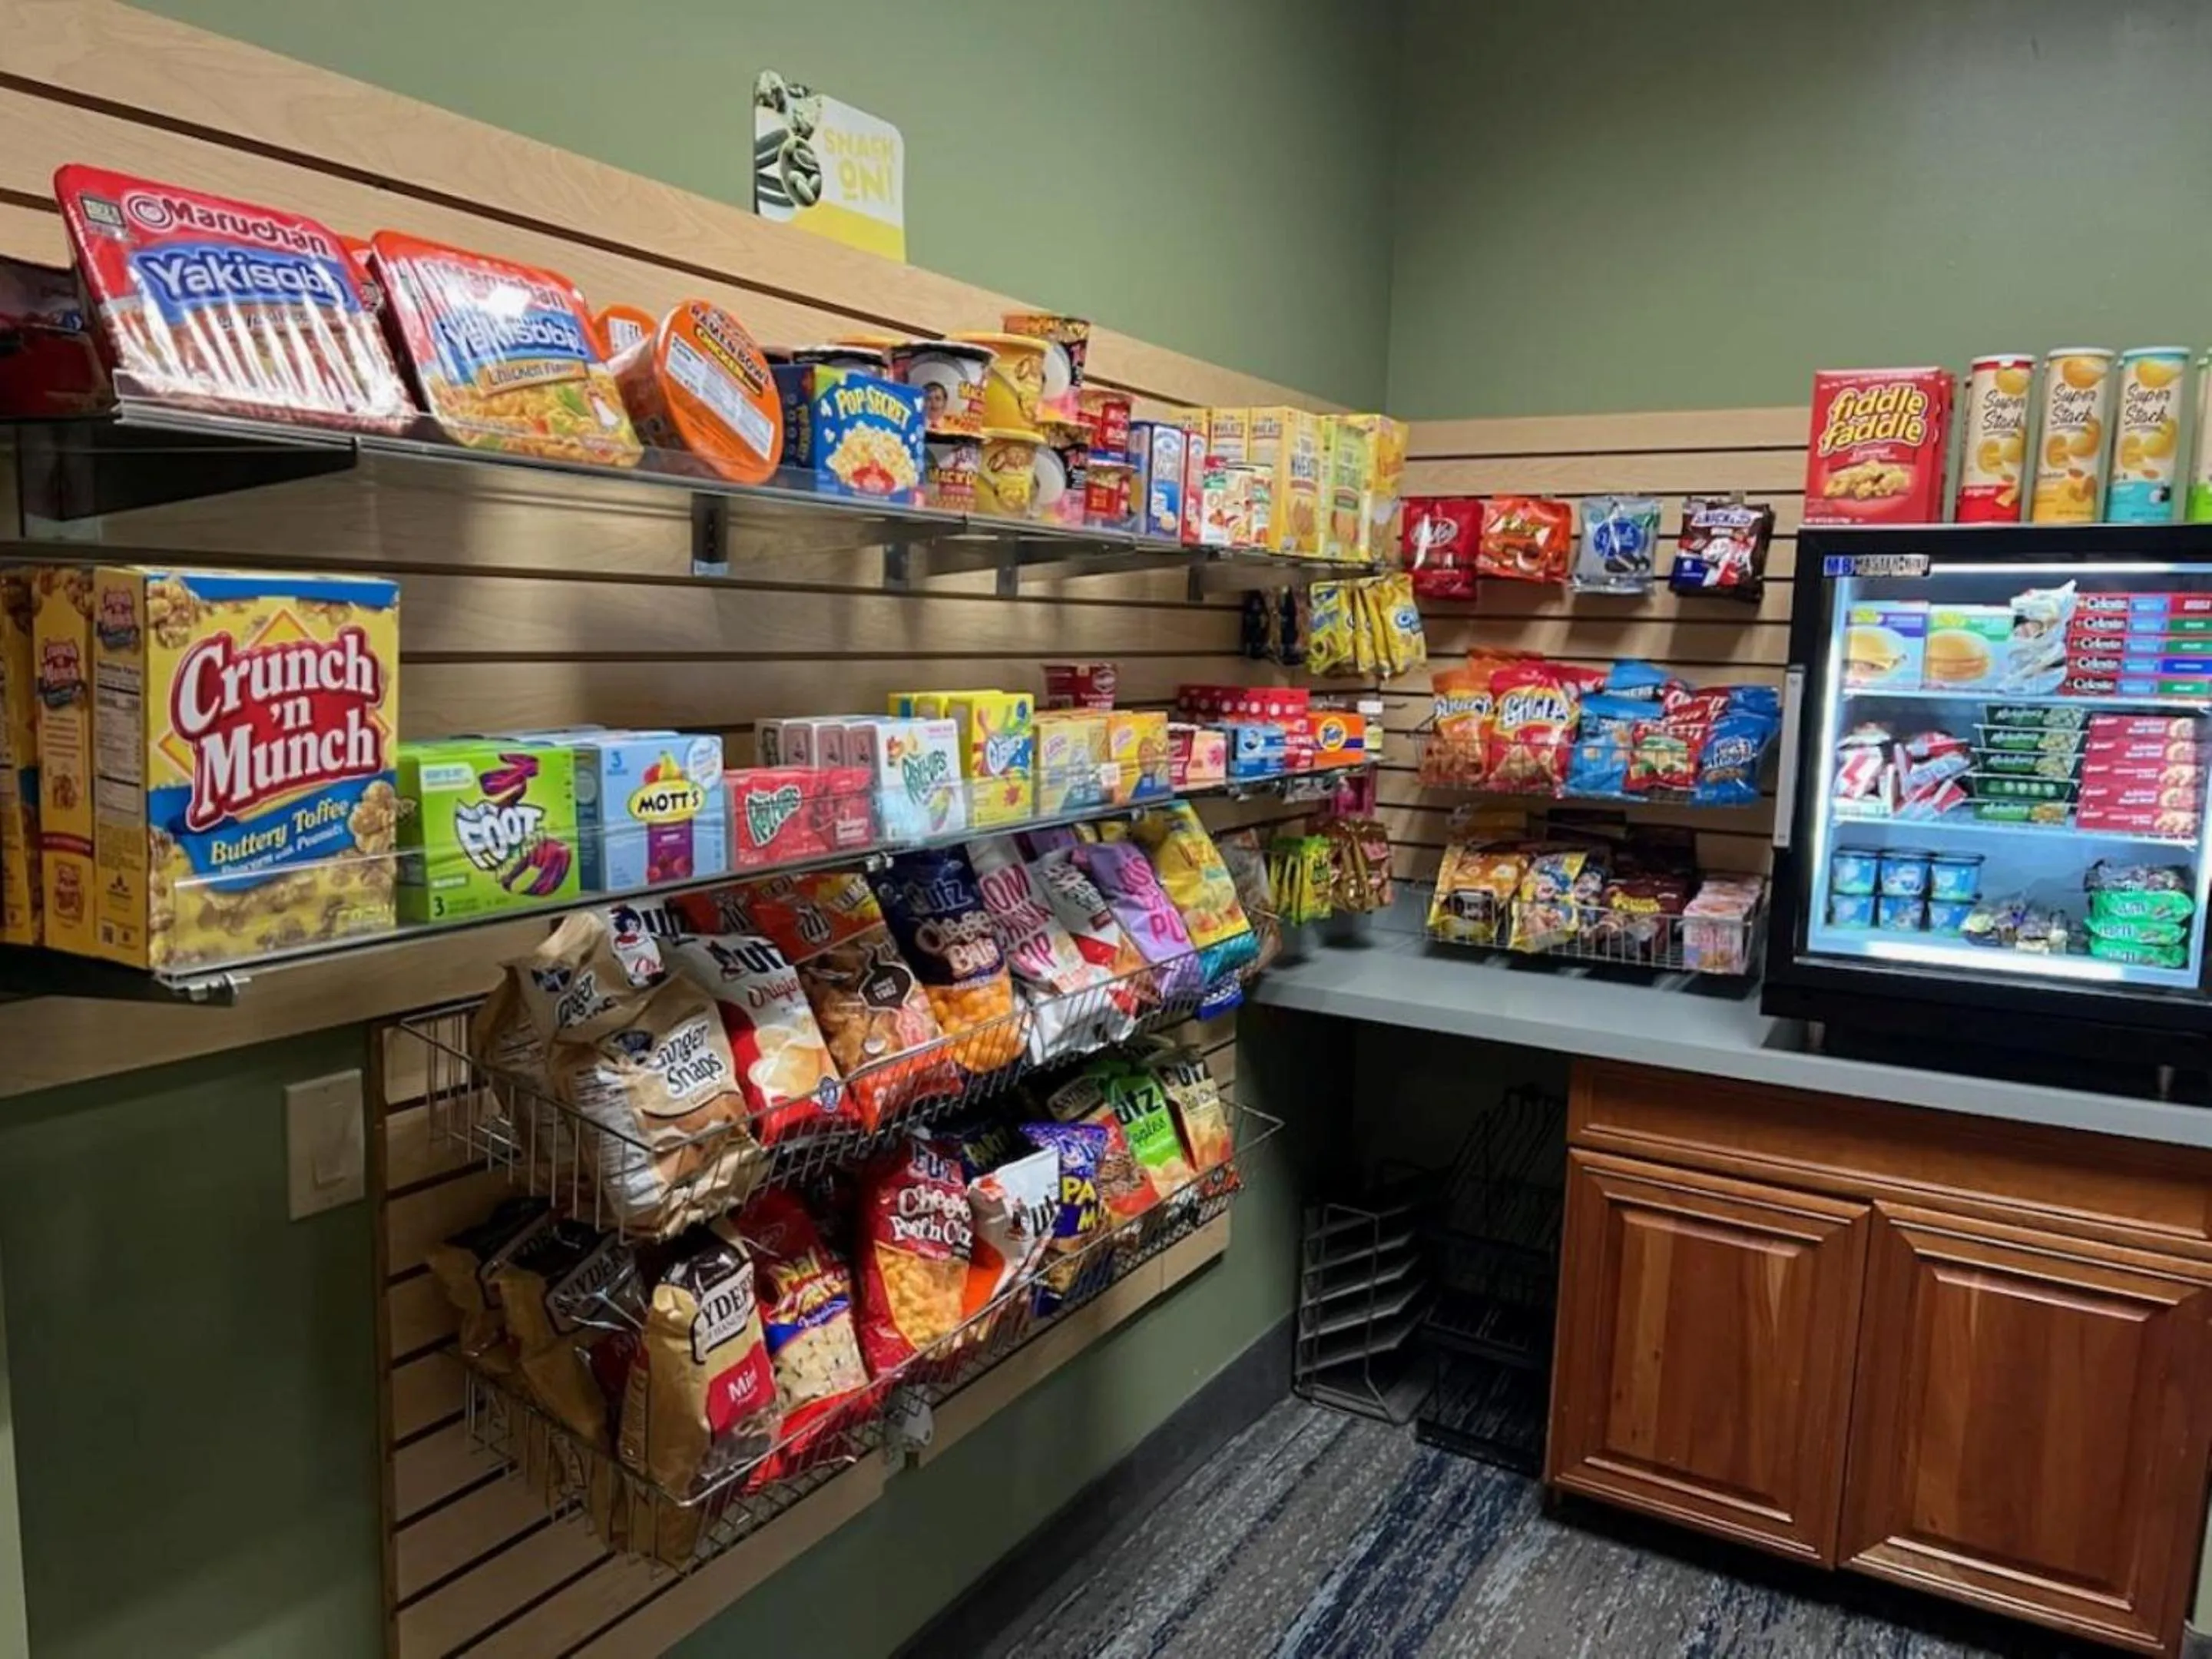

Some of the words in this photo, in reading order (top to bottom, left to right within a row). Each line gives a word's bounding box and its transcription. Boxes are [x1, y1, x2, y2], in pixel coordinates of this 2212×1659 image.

[161, 197, 329, 256] Maruchan
[1832, 385, 1923, 422] fiddle
[1821, 413, 1922, 452] faddle
[179, 633, 376, 733] Crunch
[270, 695, 312, 730] 'n
[196, 707, 376, 819] Munch
[610, 750, 622, 768] 3
[210, 823, 287, 866] Buttery
[291, 797, 350, 834] Toffee
[433, 896, 445, 917] 3
[915, 909, 993, 955] Cheese
[949, 936, 1000, 980] Balls
[666, 1052, 724, 1095] Snaps
[897, 1184, 972, 1222] Cheese
